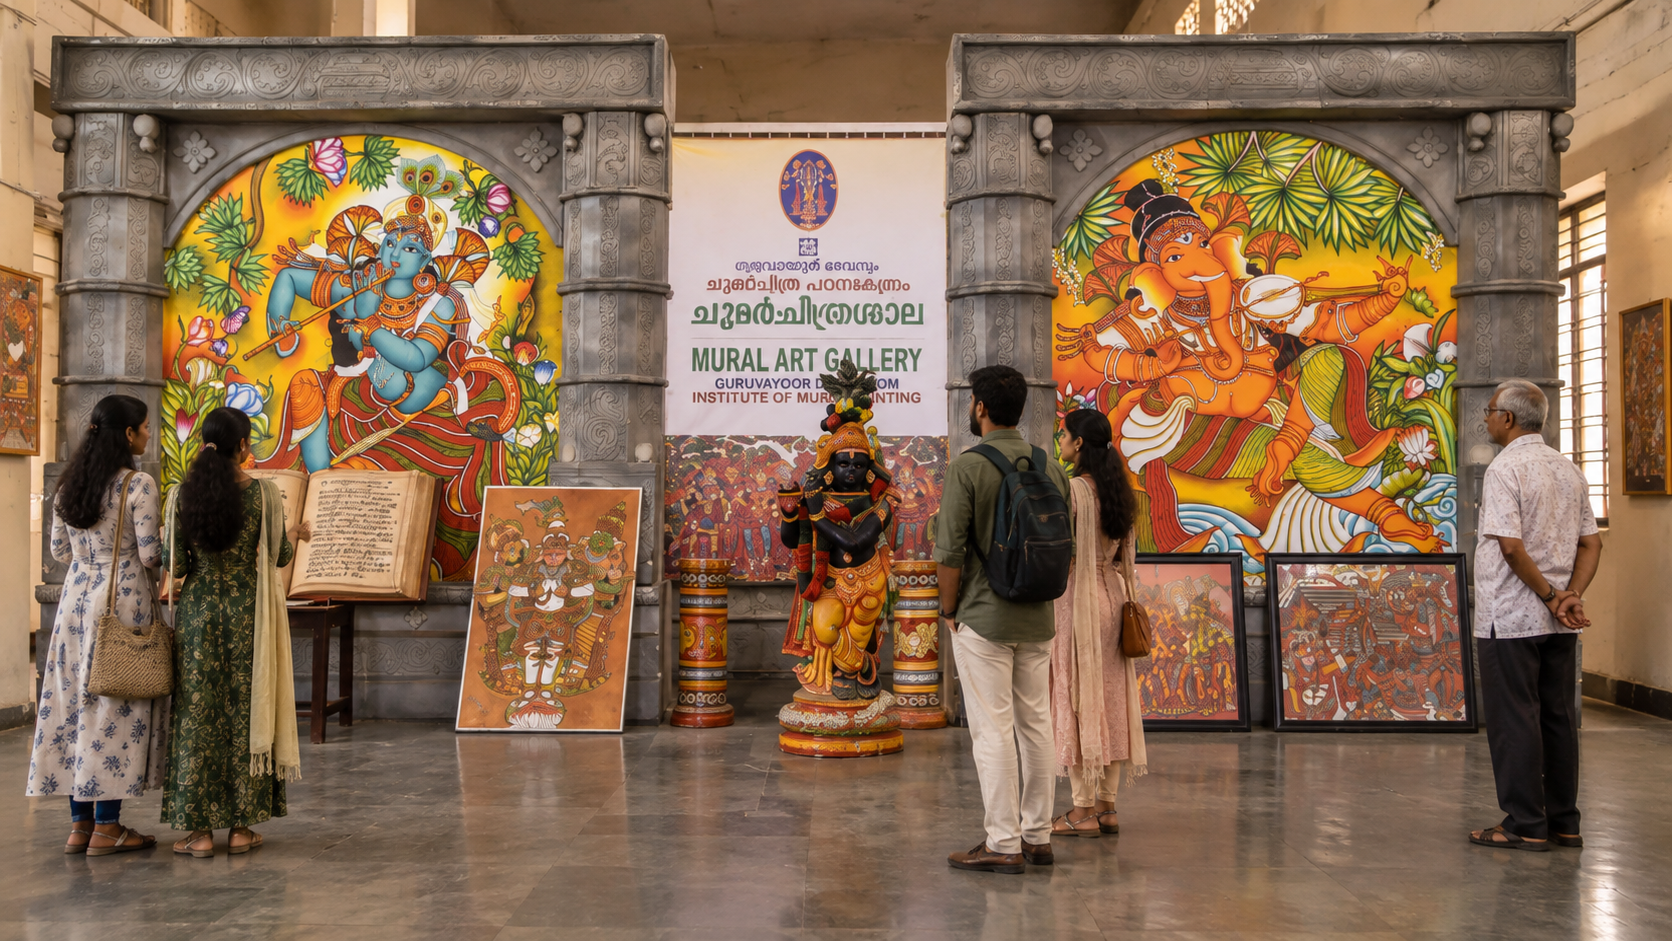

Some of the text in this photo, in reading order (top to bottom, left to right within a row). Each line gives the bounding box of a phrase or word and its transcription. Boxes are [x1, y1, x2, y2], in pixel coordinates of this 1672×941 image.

[691, 347, 770, 372] MURAL
[774, 347, 819, 372] ART
[714, 377, 812, 390] GURUVAYOOR
[692, 391, 922, 404] INSTITUTE OF MUR INTING
